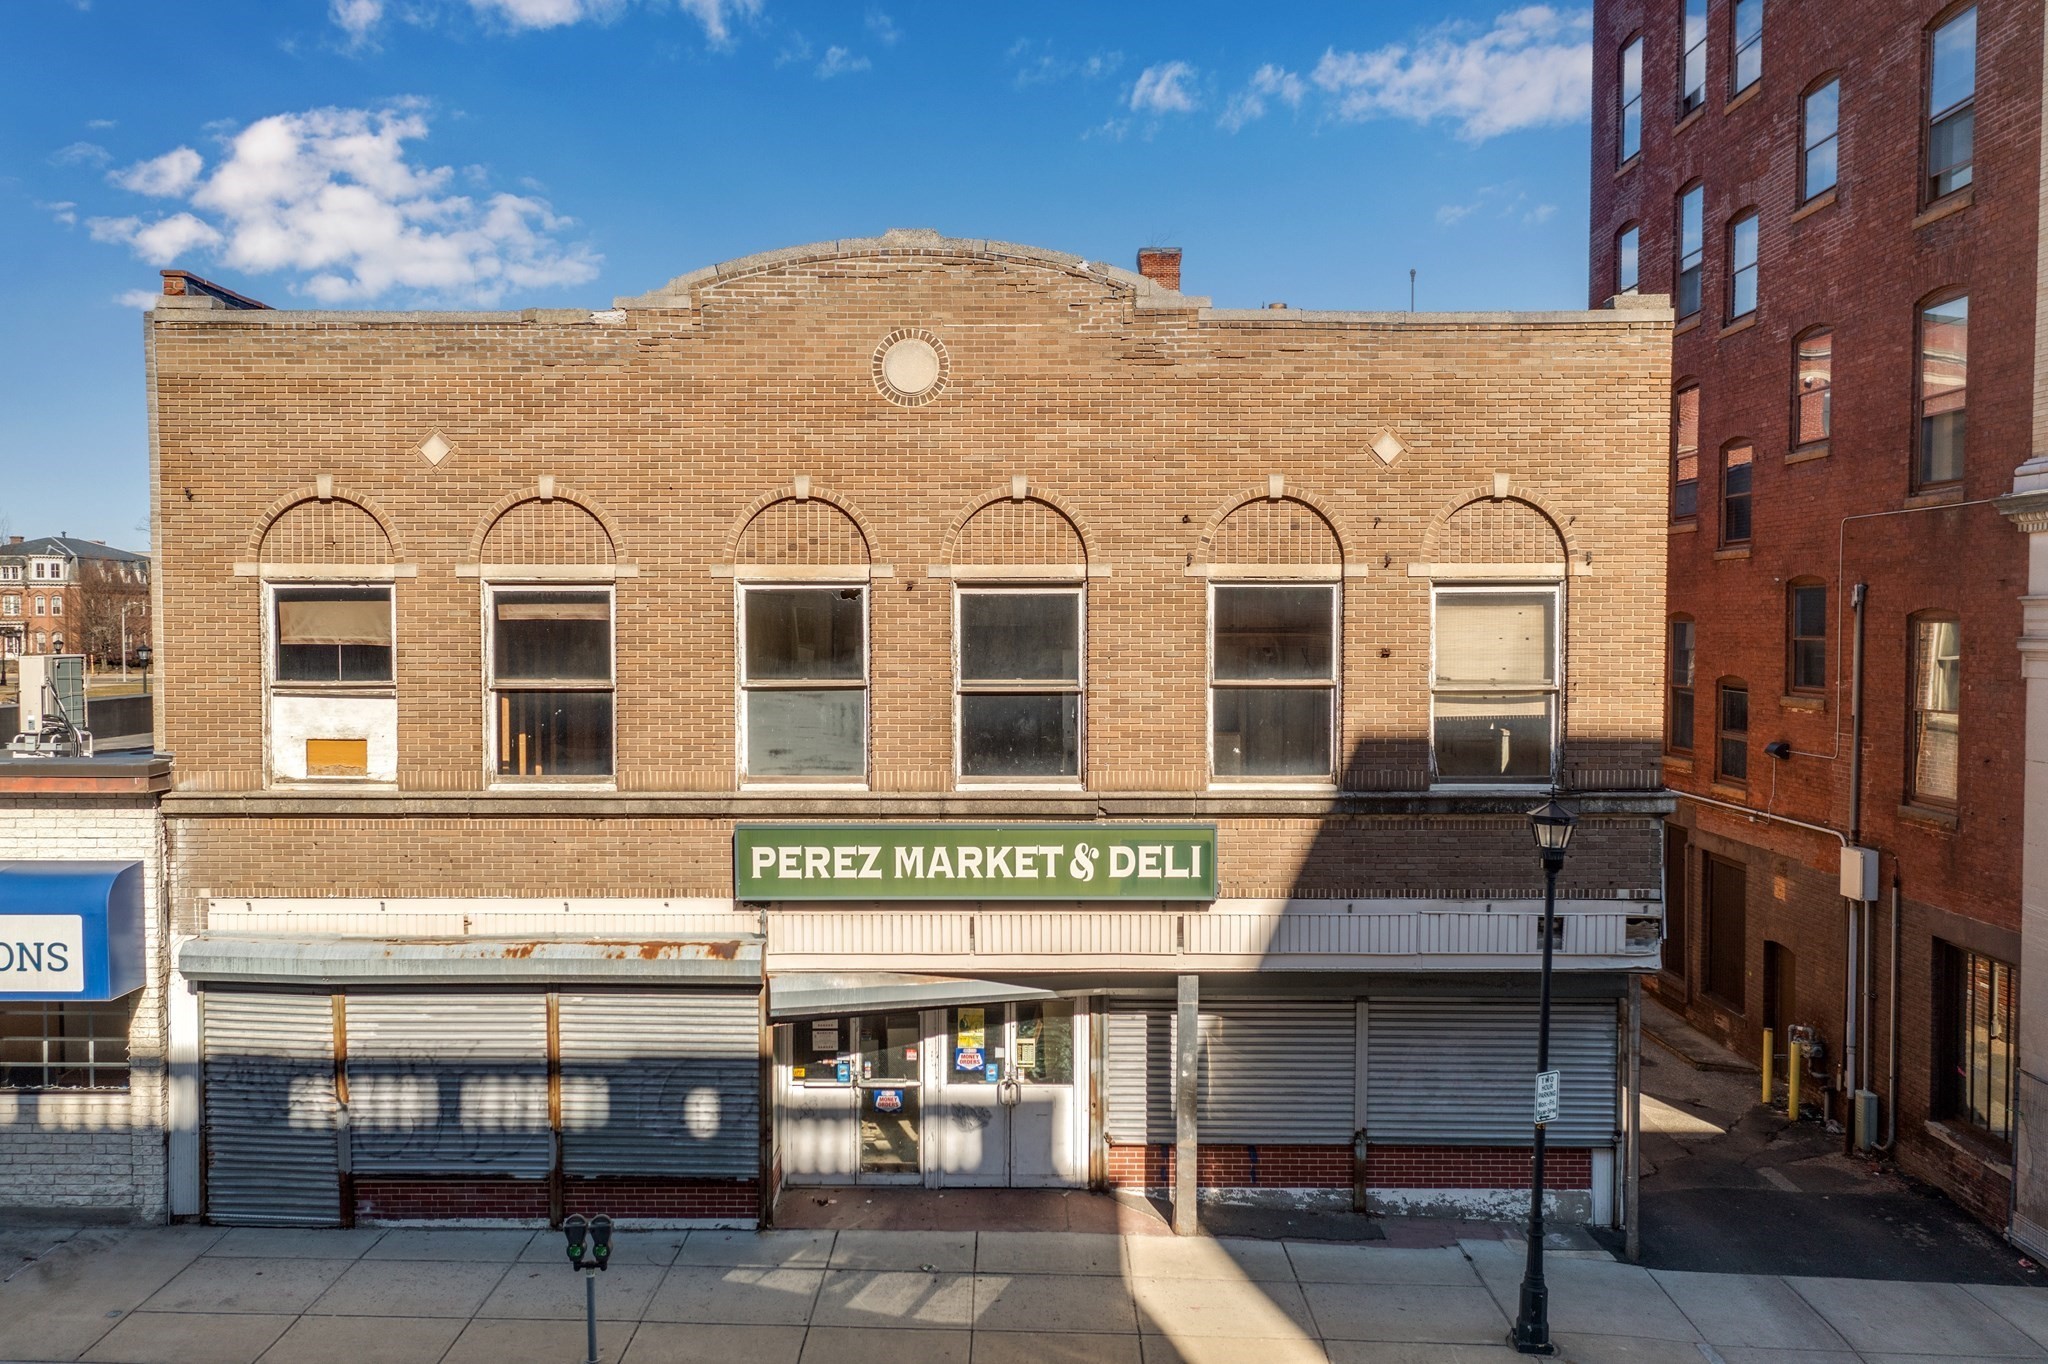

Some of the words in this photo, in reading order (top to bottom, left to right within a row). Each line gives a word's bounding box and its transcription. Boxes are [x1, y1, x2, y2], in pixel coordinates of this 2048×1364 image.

[751, 845, 882, 879] PEREZ
[894, 845, 1063, 879] MARKET
[1069, 842, 1099, 882] &
[1109, 845, 1202, 879] DELI
[1541, 1075, 1554, 1084] TWO
[1538, 1090, 1556, 1098] PARKING
